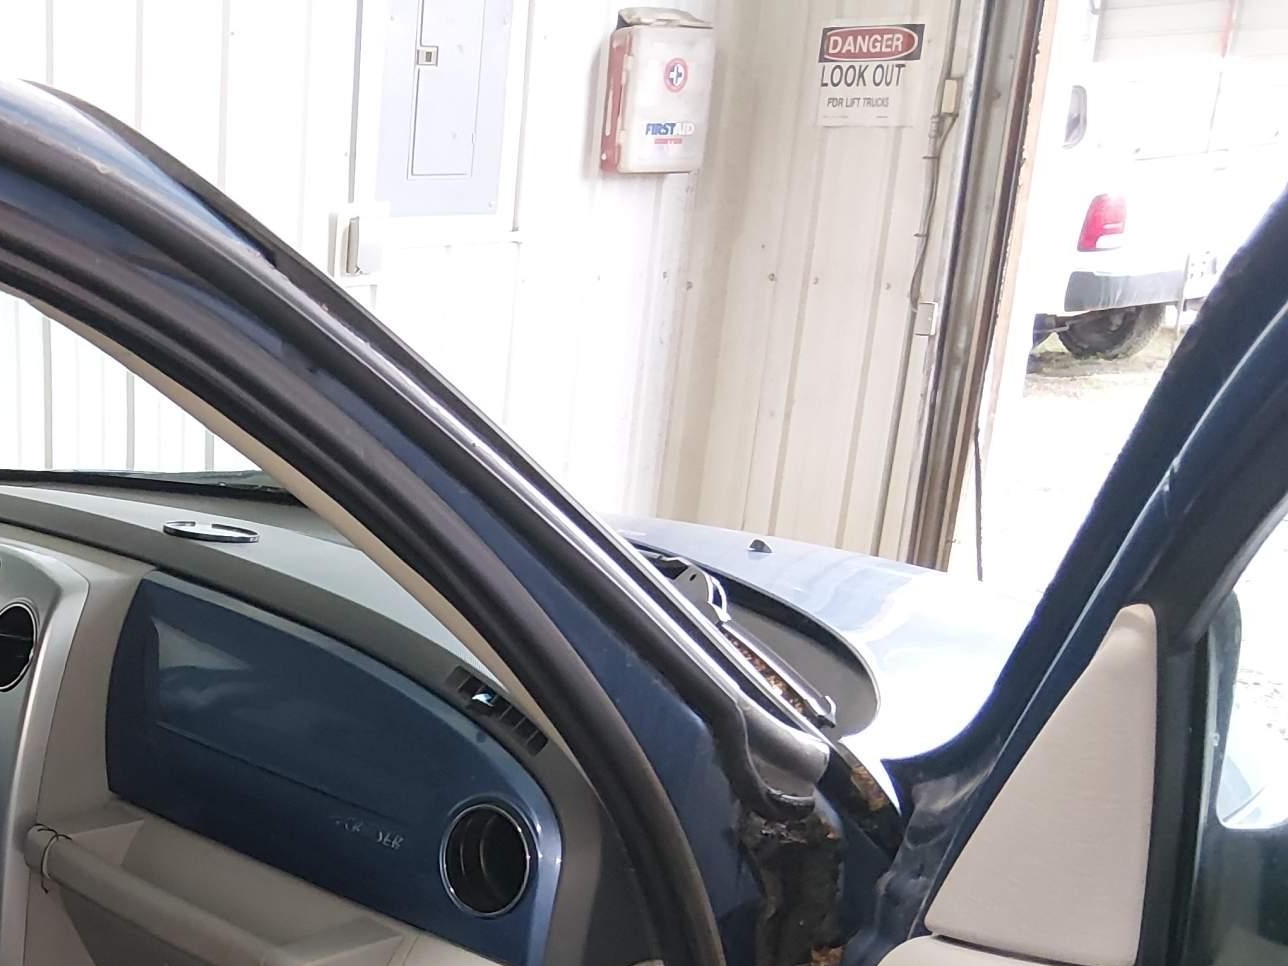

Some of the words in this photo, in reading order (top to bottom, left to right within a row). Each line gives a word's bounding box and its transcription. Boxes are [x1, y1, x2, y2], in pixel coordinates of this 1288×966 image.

[828, 33, 904, 54] DANGER
[820, 64, 869, 88] LOOK
[872, 63, 906, 87] OUT
[826, 97, 844, 108] FOR
[845, 97, 861, 108] LIFT
[862, 96, 889, 108] TRUCKS
